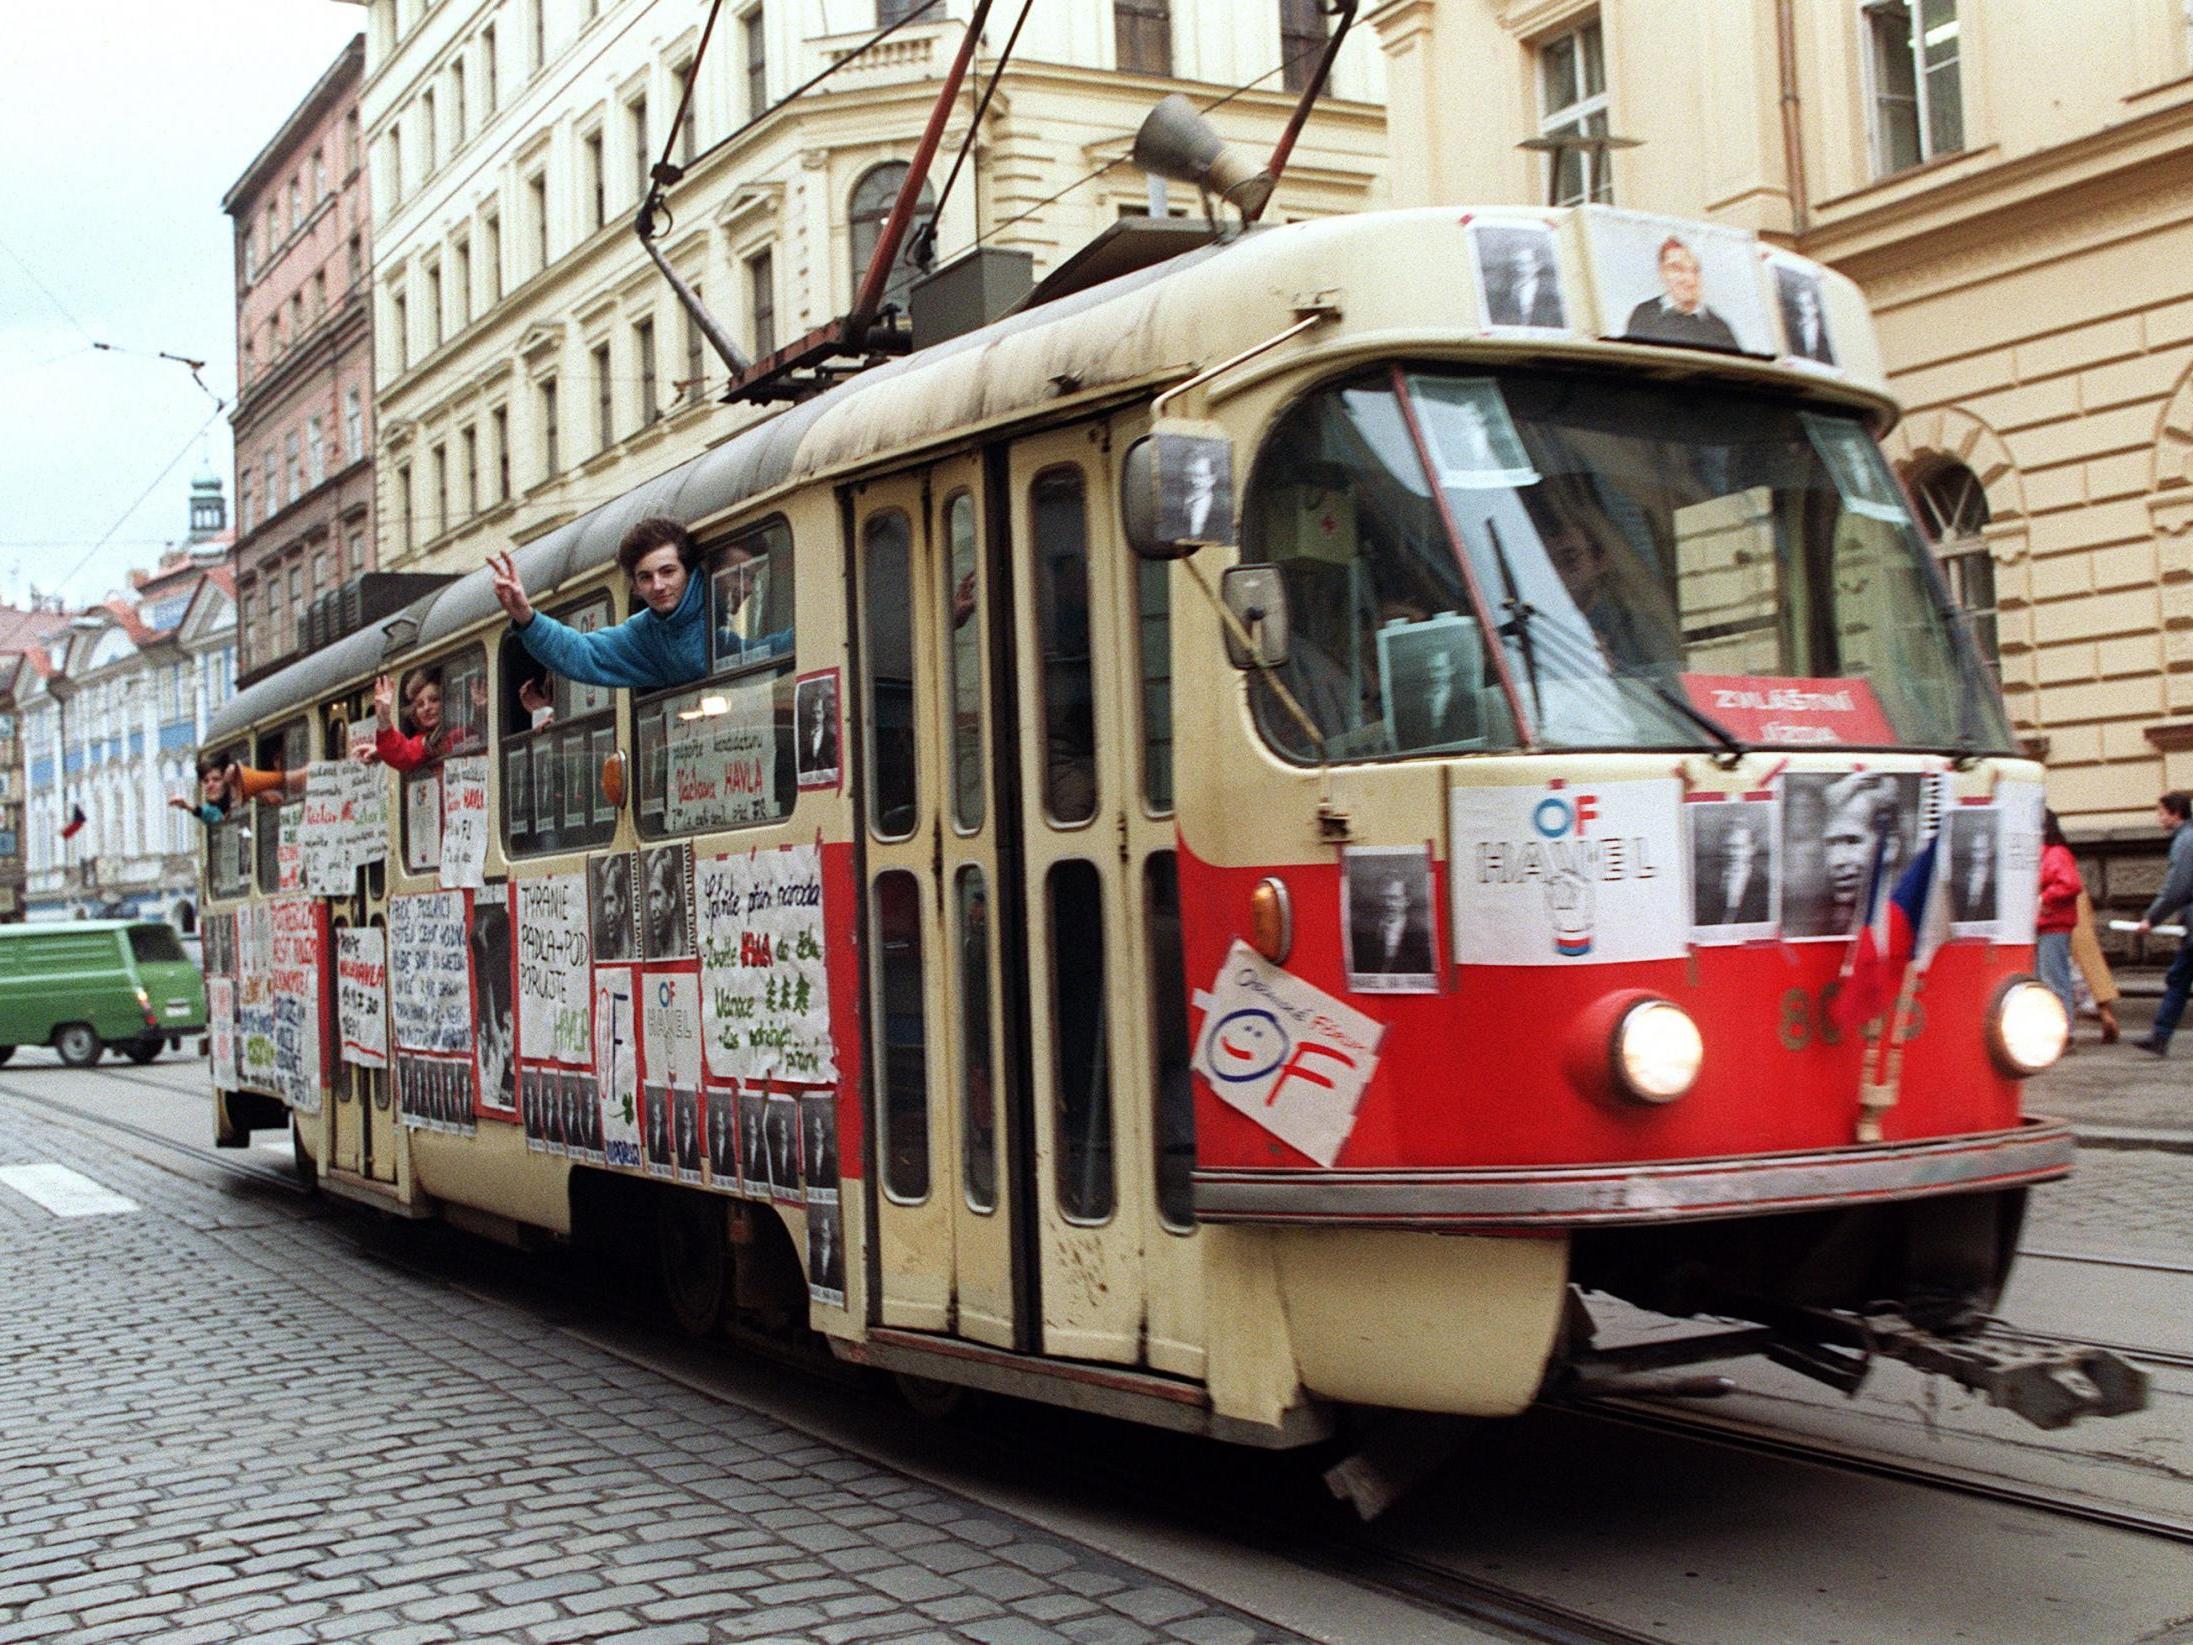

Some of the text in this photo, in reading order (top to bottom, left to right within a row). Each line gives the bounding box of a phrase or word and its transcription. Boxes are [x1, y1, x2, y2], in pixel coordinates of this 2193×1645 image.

[724, 757, 764, 796] HAVLA
[1533, 795, 1598, 838] OF
[631, 851, 639, 891] HRAD
[683, 842, 693, 884] HRAD
[1475, 836, 1658, 885] HAVEL
[521, 885, 569, 921] TYRANIE
[659, 981, 676, 1008] OF
